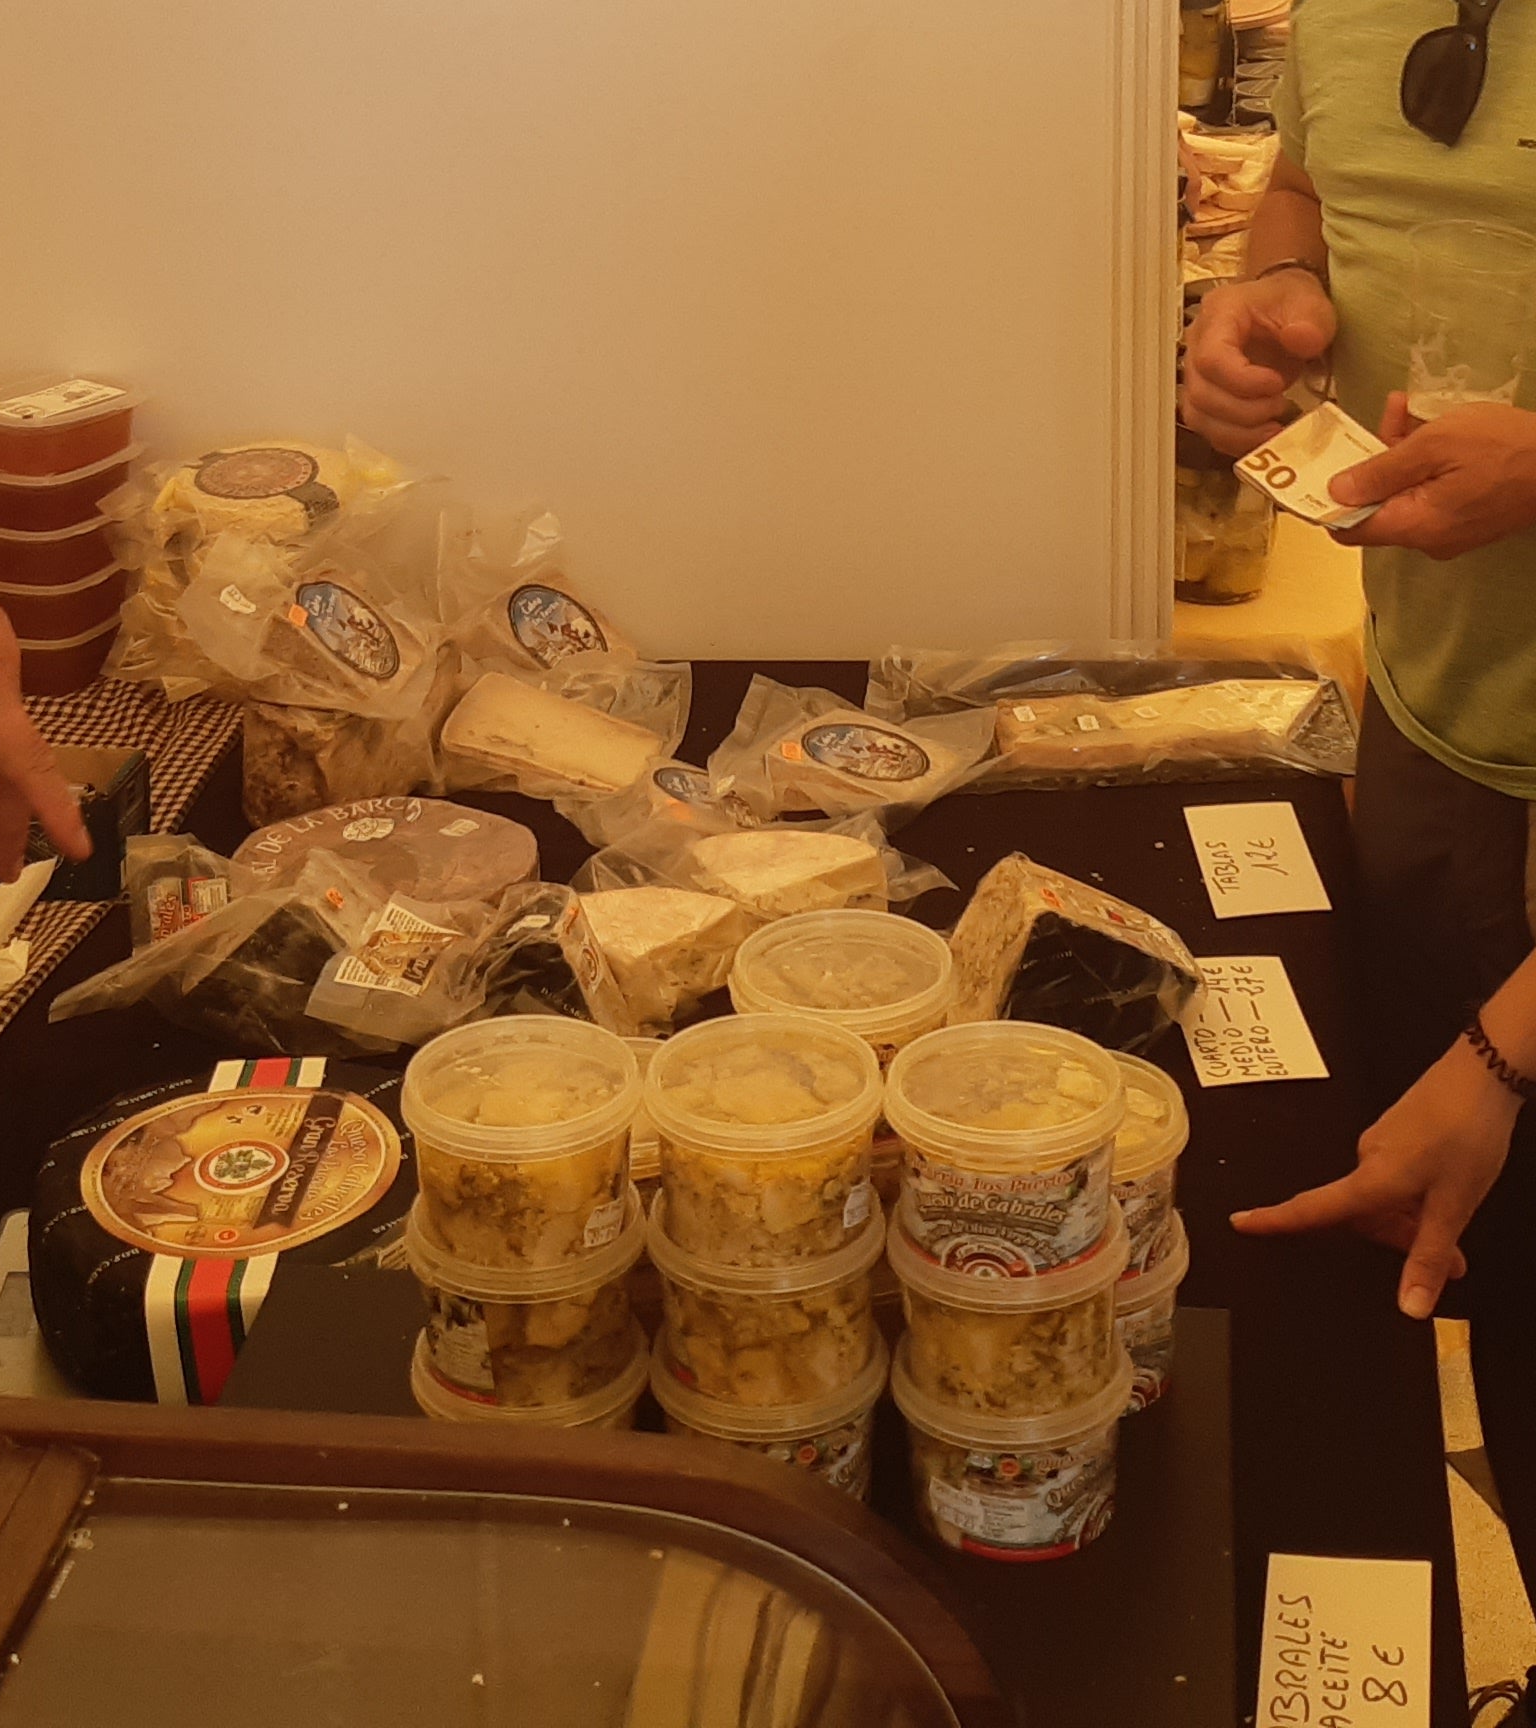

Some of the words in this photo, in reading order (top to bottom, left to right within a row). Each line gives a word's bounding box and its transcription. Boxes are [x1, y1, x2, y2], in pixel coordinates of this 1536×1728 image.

[1244, 448, 1297, 490] 50
[254, 831, 293, 855] DE
[285, 816, 324, 834] LA
[327, 797, 423, 823] BARCA
[1205, 840, 1240, 896] TABLAS
[1194, 1028, 1232, 1078] CUARTO
[958, 1194, 981, 1210] de
[983, 1196, 1066, 1222] Cabrales
[1268, 1593, 1313, 1728] BRALES
